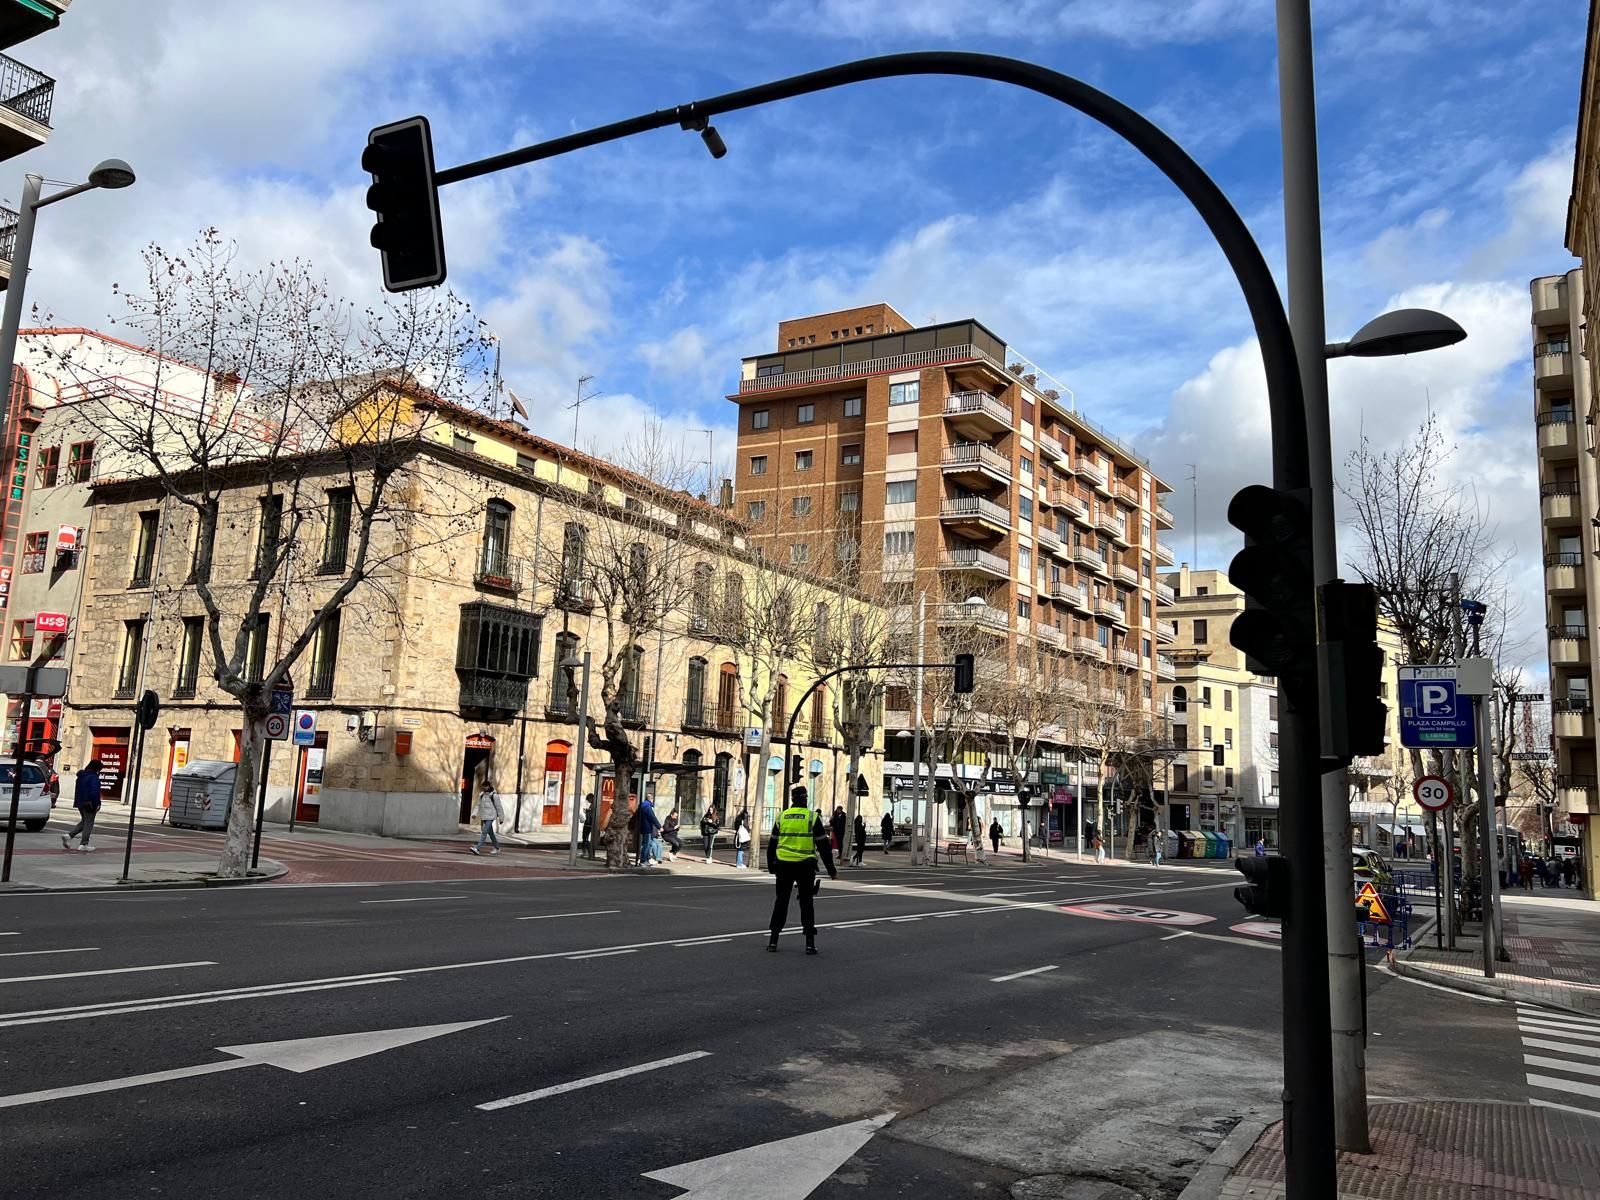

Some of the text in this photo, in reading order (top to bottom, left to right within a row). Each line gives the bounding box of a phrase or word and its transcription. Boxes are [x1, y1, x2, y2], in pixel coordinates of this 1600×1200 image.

[1413, 668, 1455, 679] Parkia
[1422, 685, 1448, 714] P
[270, 722, 281, 730] 20
[1421, 786, 1444, 800] 30
